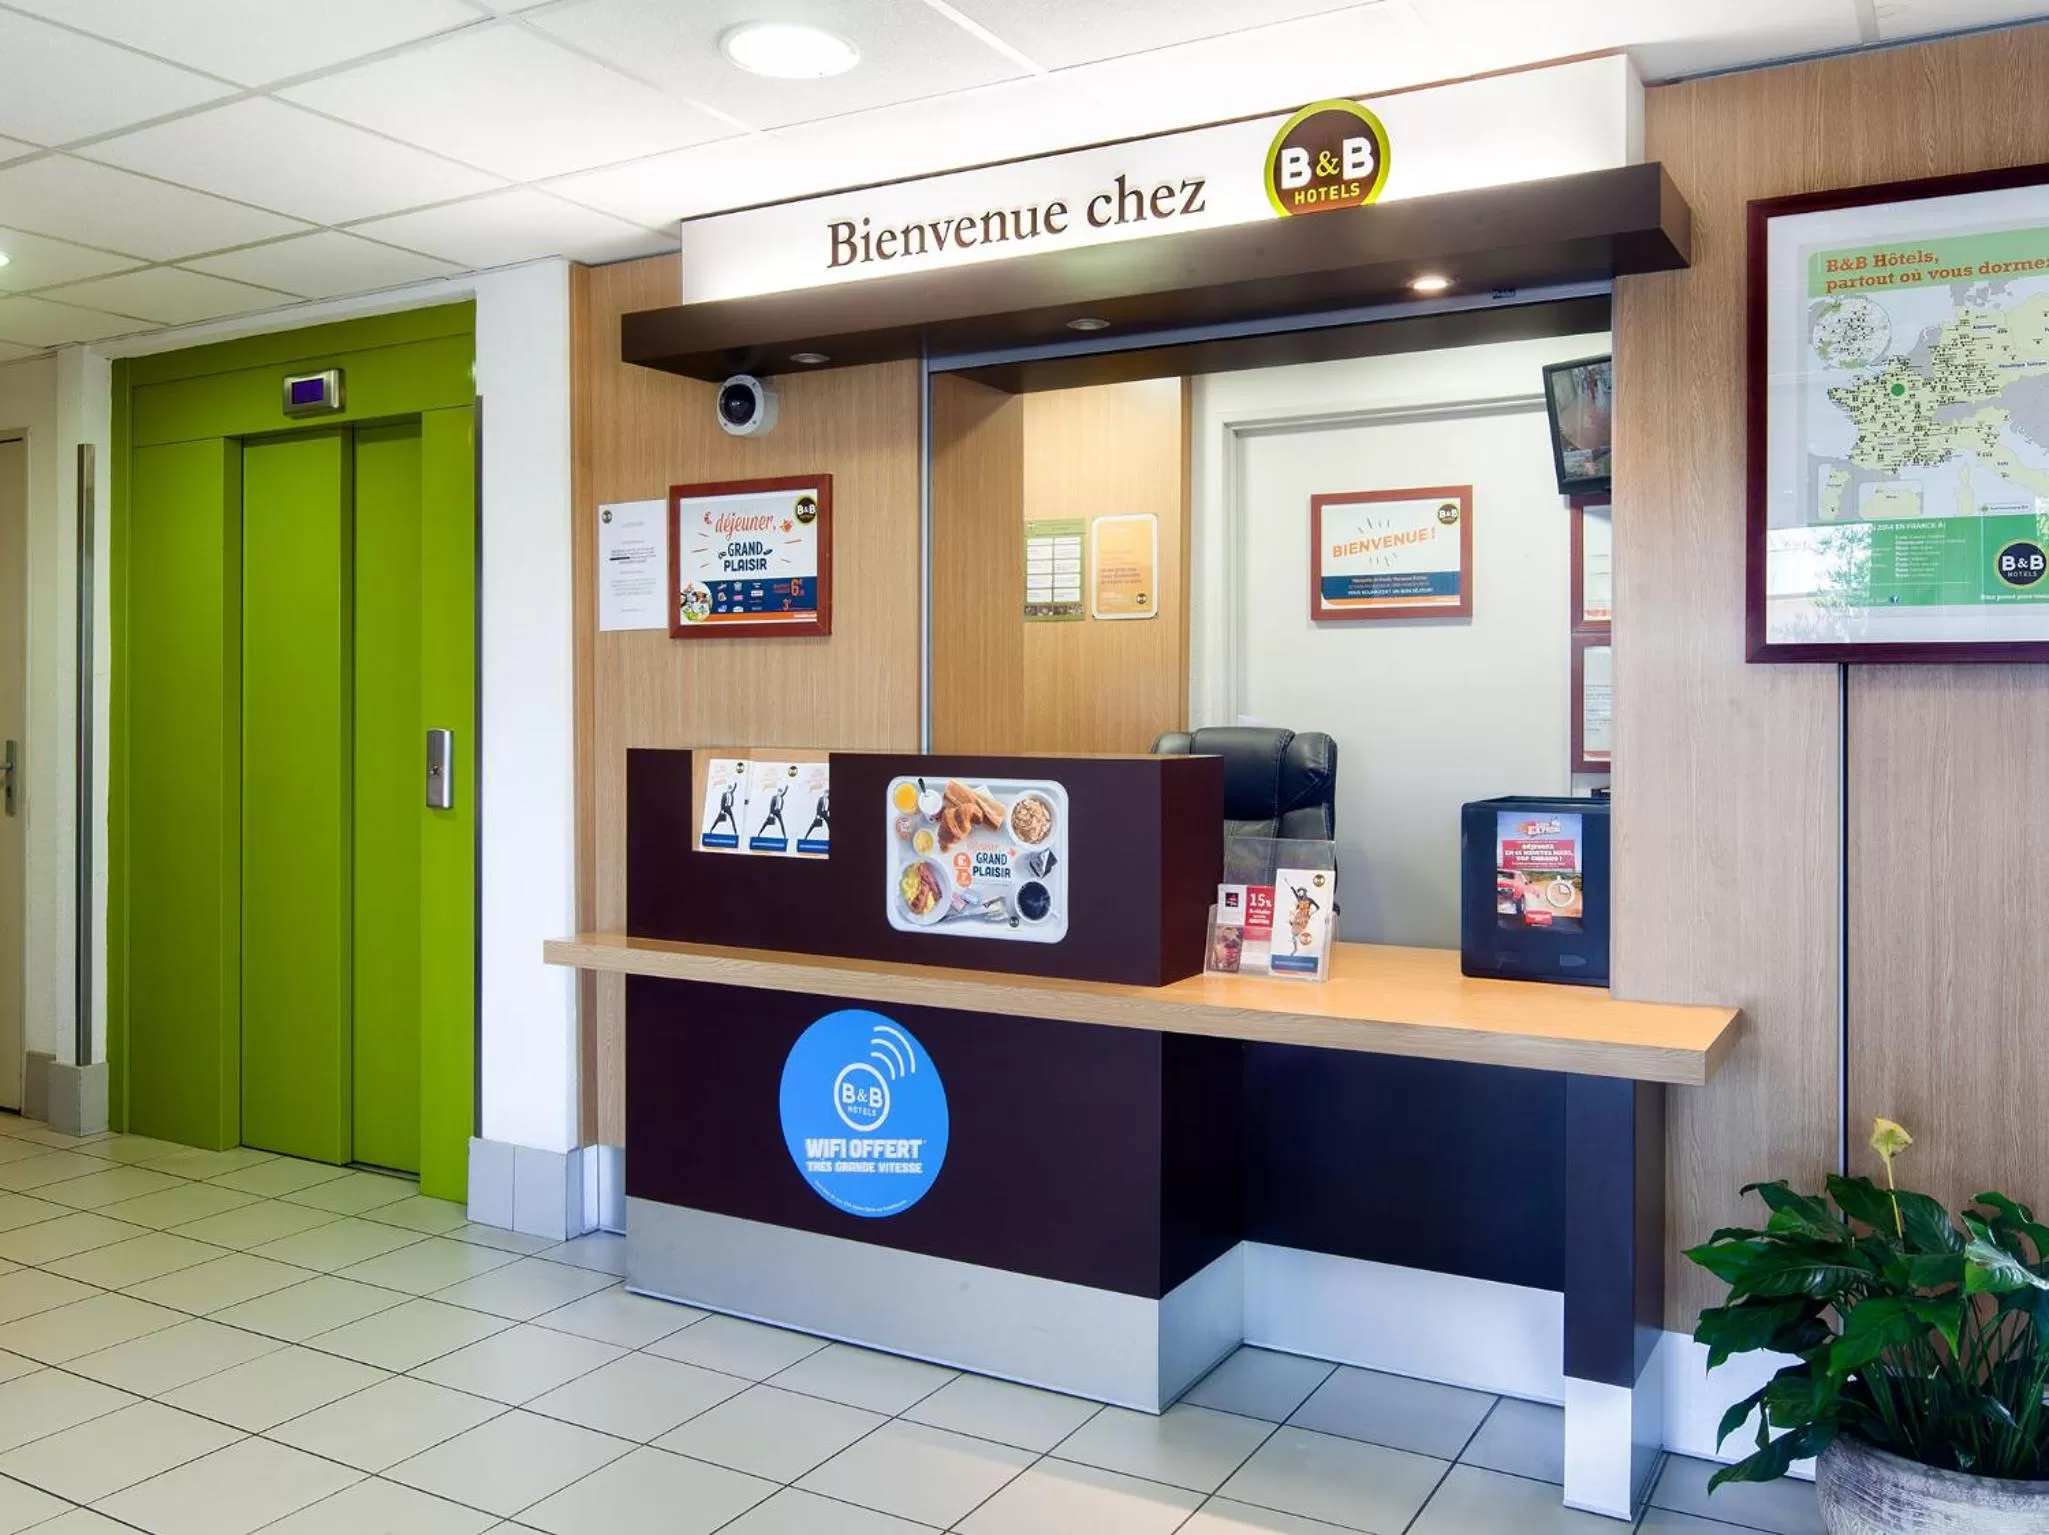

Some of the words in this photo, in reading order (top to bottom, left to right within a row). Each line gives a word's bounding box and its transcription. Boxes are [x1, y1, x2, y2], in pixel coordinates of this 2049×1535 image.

[1281, 137, 1374, 190] B&B
[1294, 183, 1361, 205] HOTELS
[826, 202, 1068, 269] Bienvenue
[1087, 175, 1206, 228] chez
[1826, 256, 1868, 273] B&B
[1872, 249, 1939, 268] Hôtels,
[1825, 272, 1896, 294] partout
[1900, 268, 1921, 284] où
[1928, 264, 1972, 281] vous
[727, 541, 763, 557] GRAND
[724, 558, 767, 573] PLAISIR
[2002, 554, 2044, 571] B&B
[976, 852, 1008, 866] GRAND
[972, 866, 1012, 878] PLAISIR
[842, 1083, 883, 1108] B&B
[847, 1105, 877, 1117] HOTELS
[805, 1138, 847, 1159] WIFI
[835, 1161, 876, 1173] GRANDE
[878, 1161, 923, 1174] VITESSE
